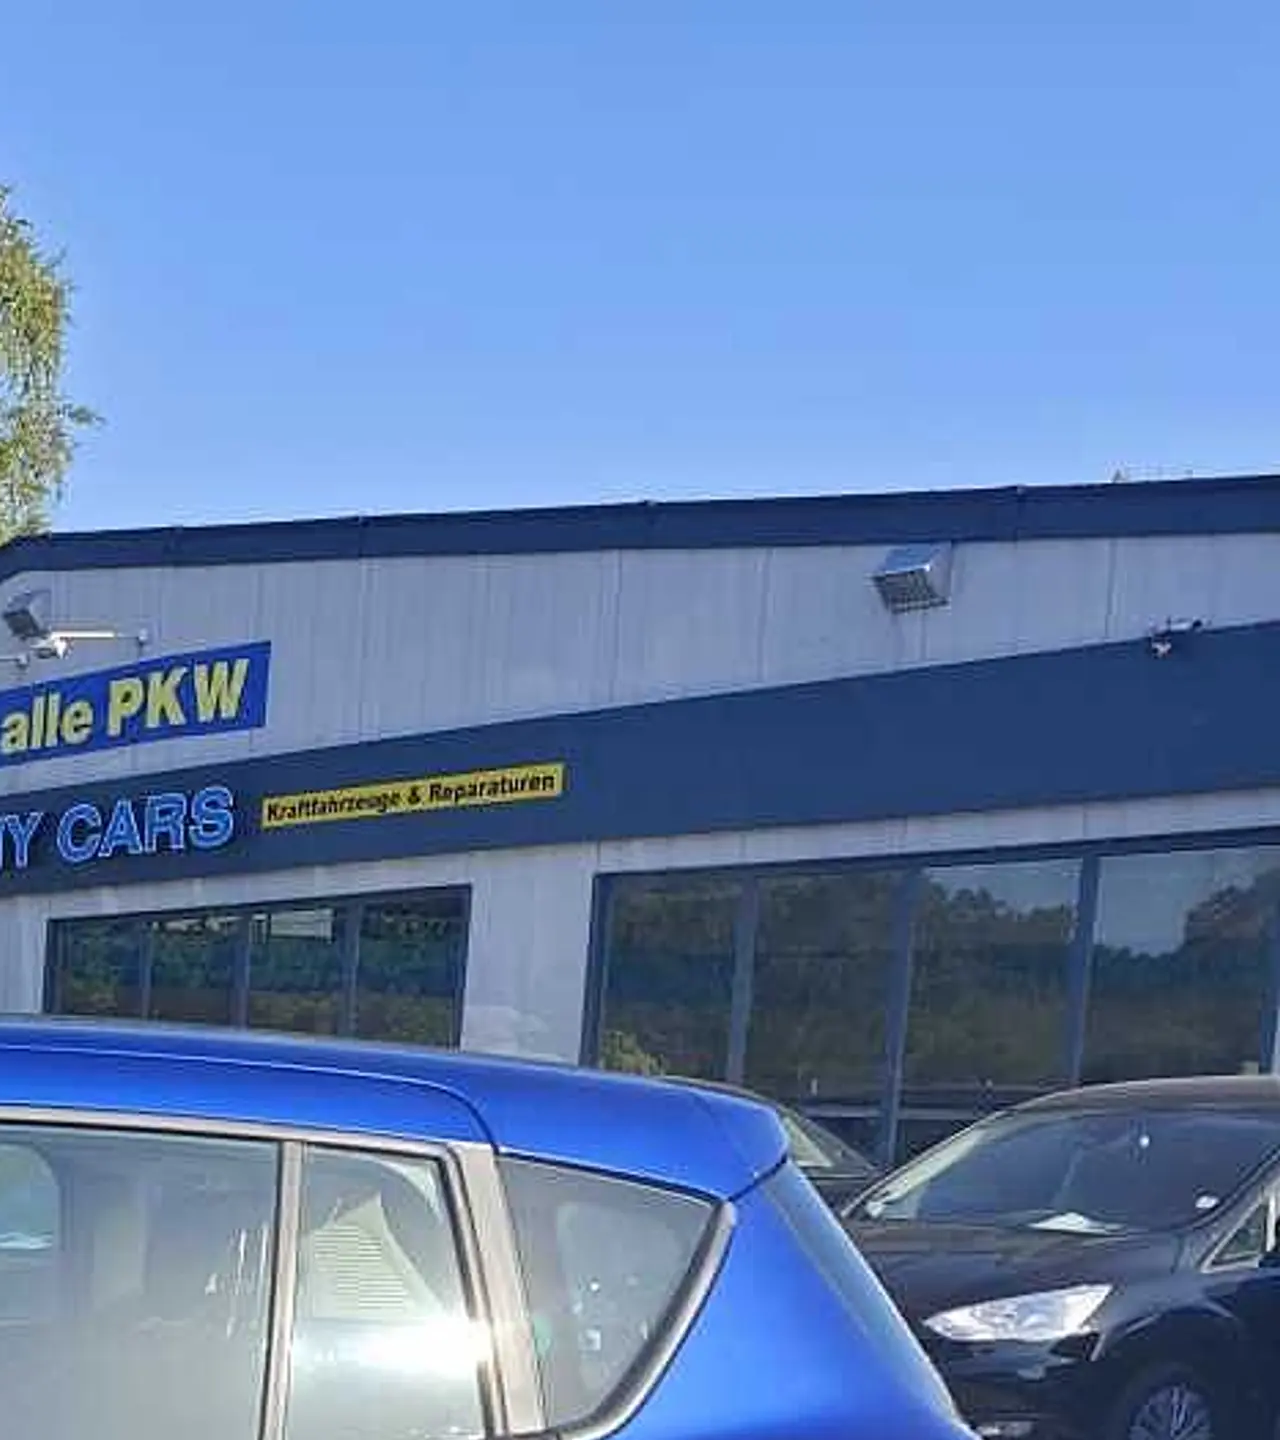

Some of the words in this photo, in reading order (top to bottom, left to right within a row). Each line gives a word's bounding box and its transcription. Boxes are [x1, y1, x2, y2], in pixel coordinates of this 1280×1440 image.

[0, 691, 92, 755] alle
[107, 658, 249, 737] PKW
[57, 785, 234, 863] CARS
[267, 788, 401, 822] Kraftfahrzeuge
[429, 772, 555, 806] Reparaturen
